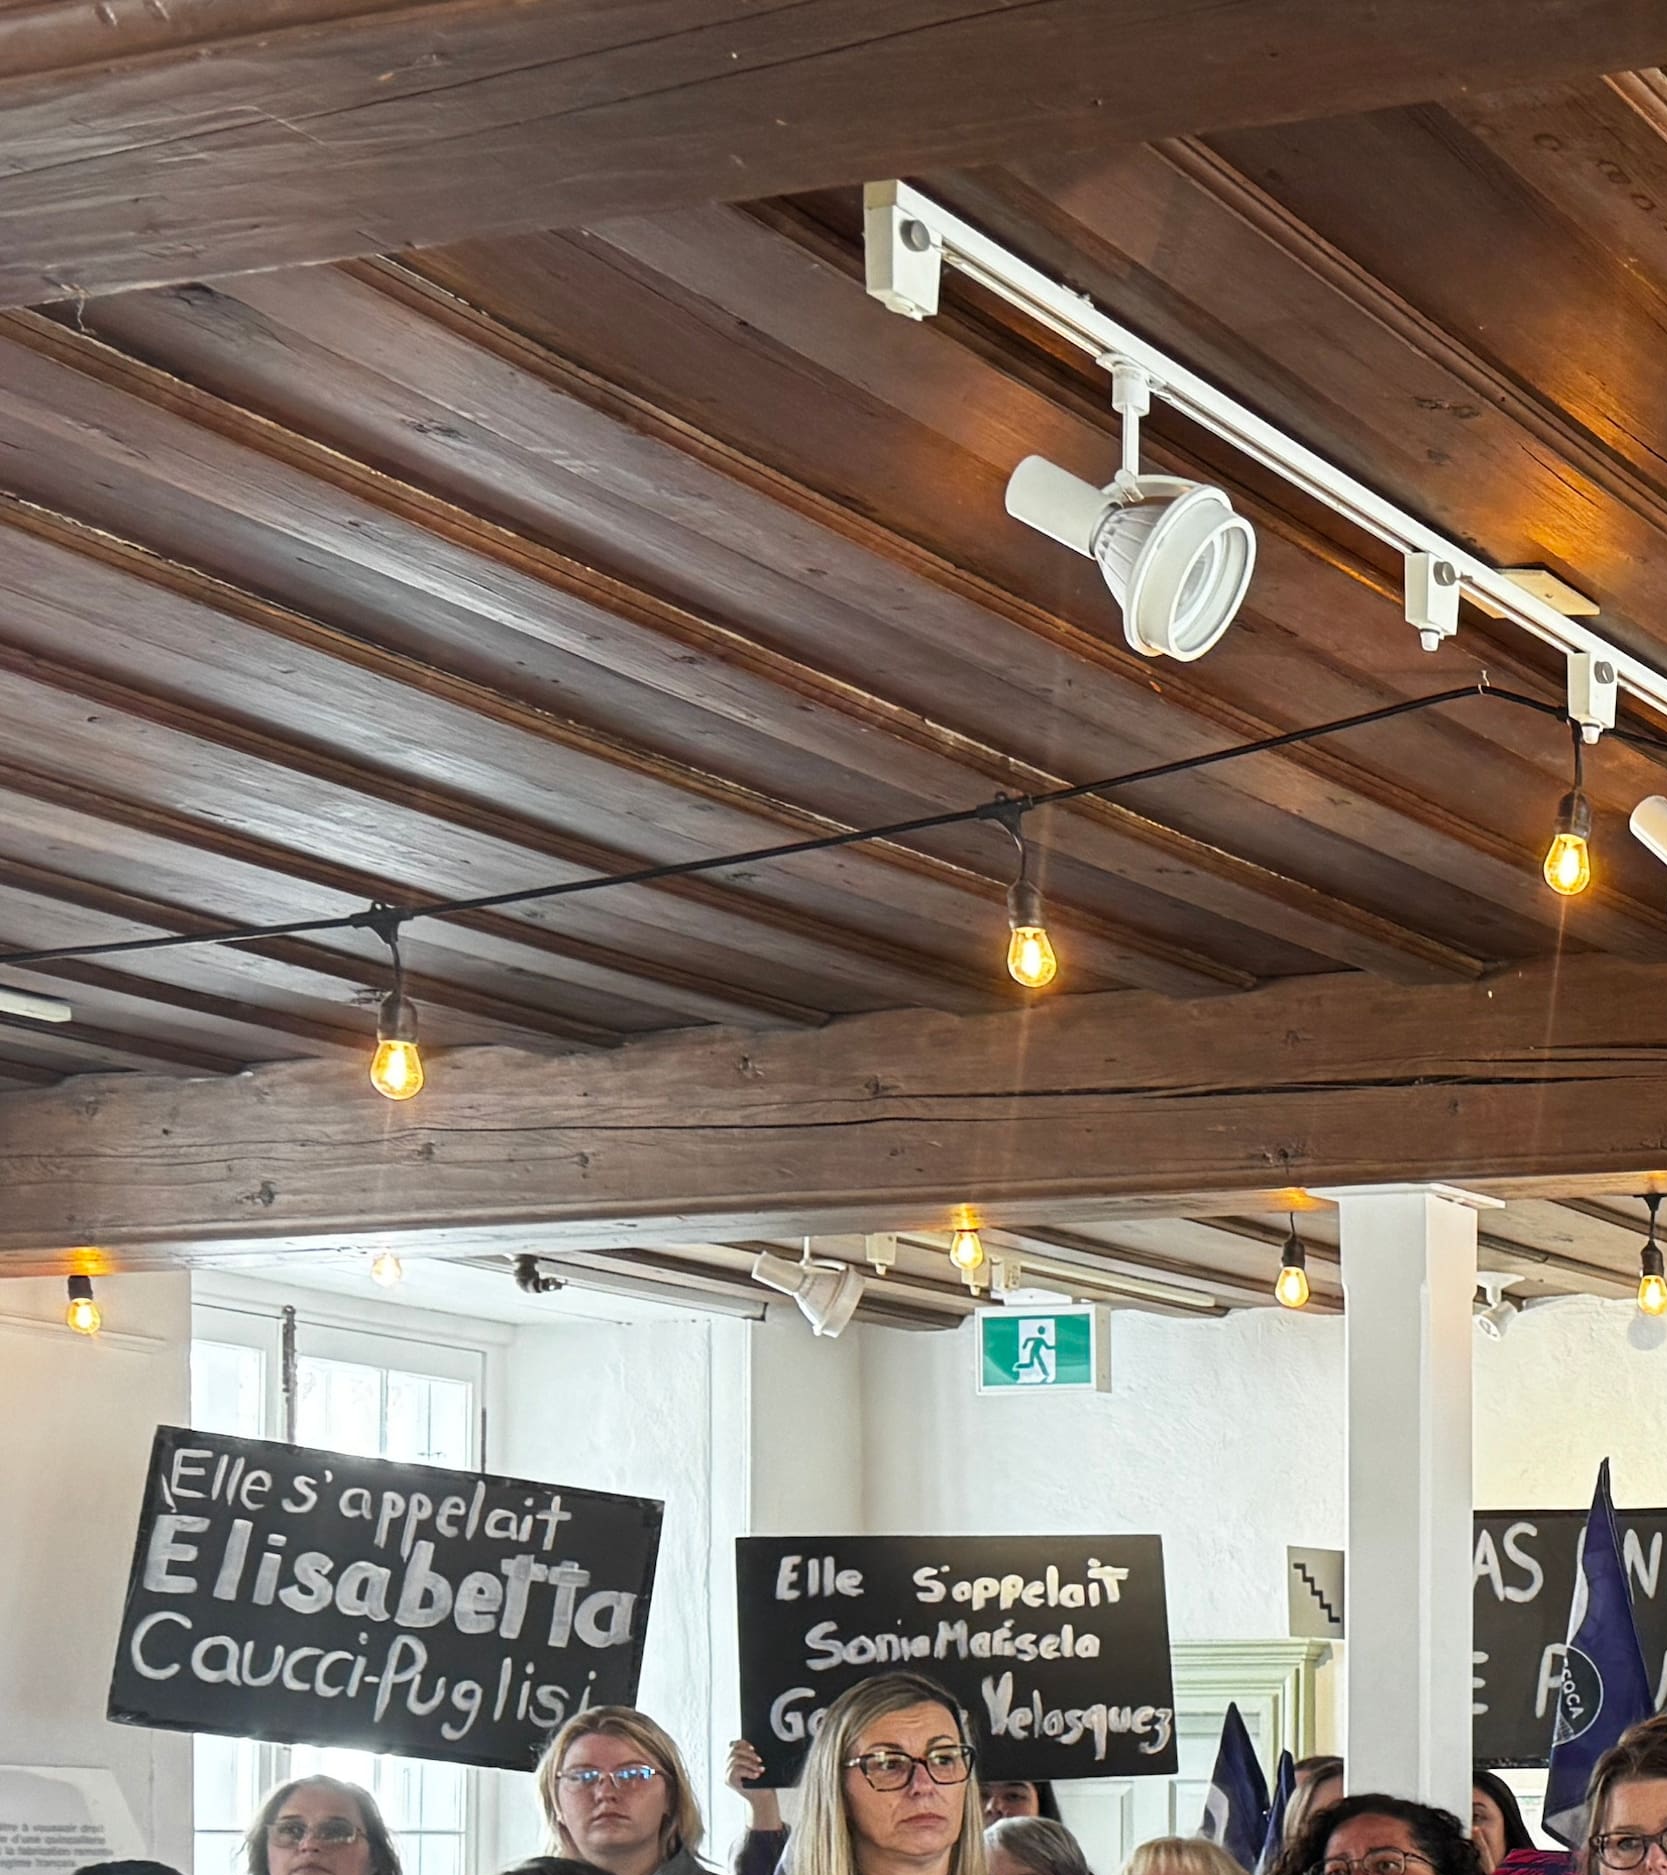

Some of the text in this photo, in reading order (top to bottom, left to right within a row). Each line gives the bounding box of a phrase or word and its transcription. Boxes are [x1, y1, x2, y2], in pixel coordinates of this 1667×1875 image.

[172, 1448, 572, 1560] Elle s'appelait
[775, 1555, 864, 1601] Elle
[131, 1611, 597, 1741] Caucci-Puglisi
